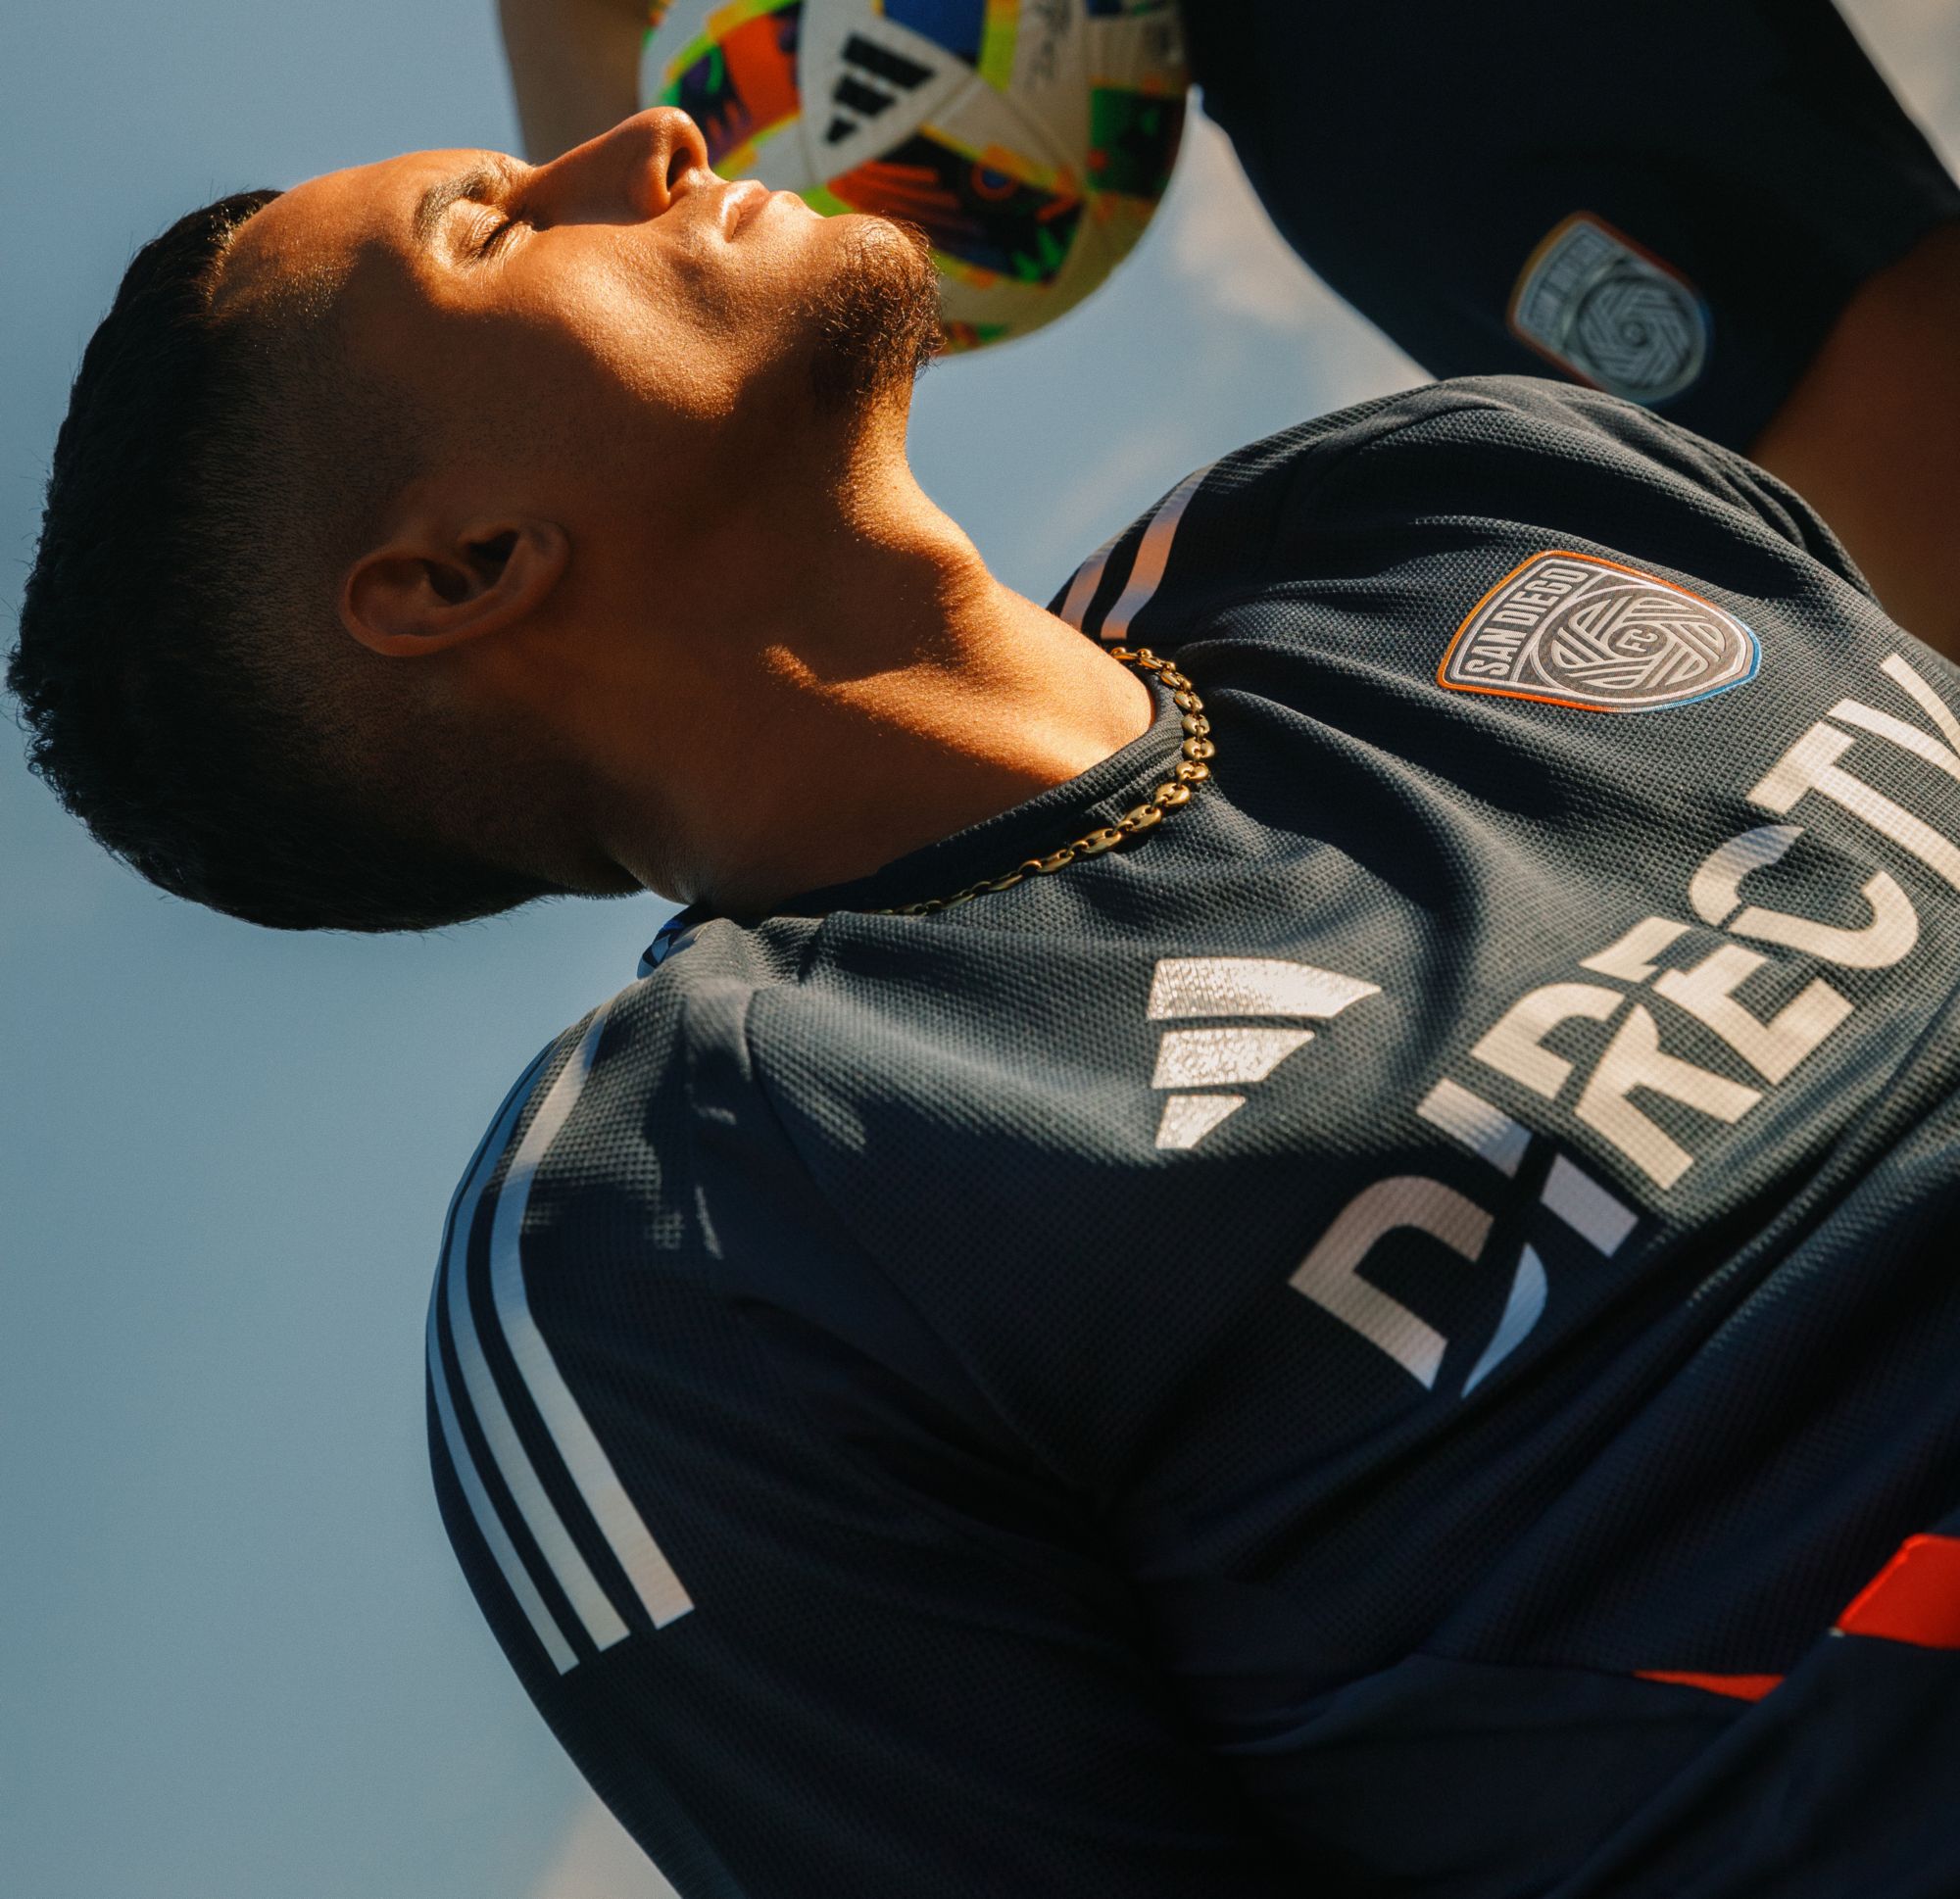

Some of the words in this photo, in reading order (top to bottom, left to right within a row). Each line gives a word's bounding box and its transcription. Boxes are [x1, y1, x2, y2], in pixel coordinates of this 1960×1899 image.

[1492, 567, 1590, 627] DIEGO
[1464, 627, 1527, 676] SAN
[1618, 628, 1658, 654] FC
